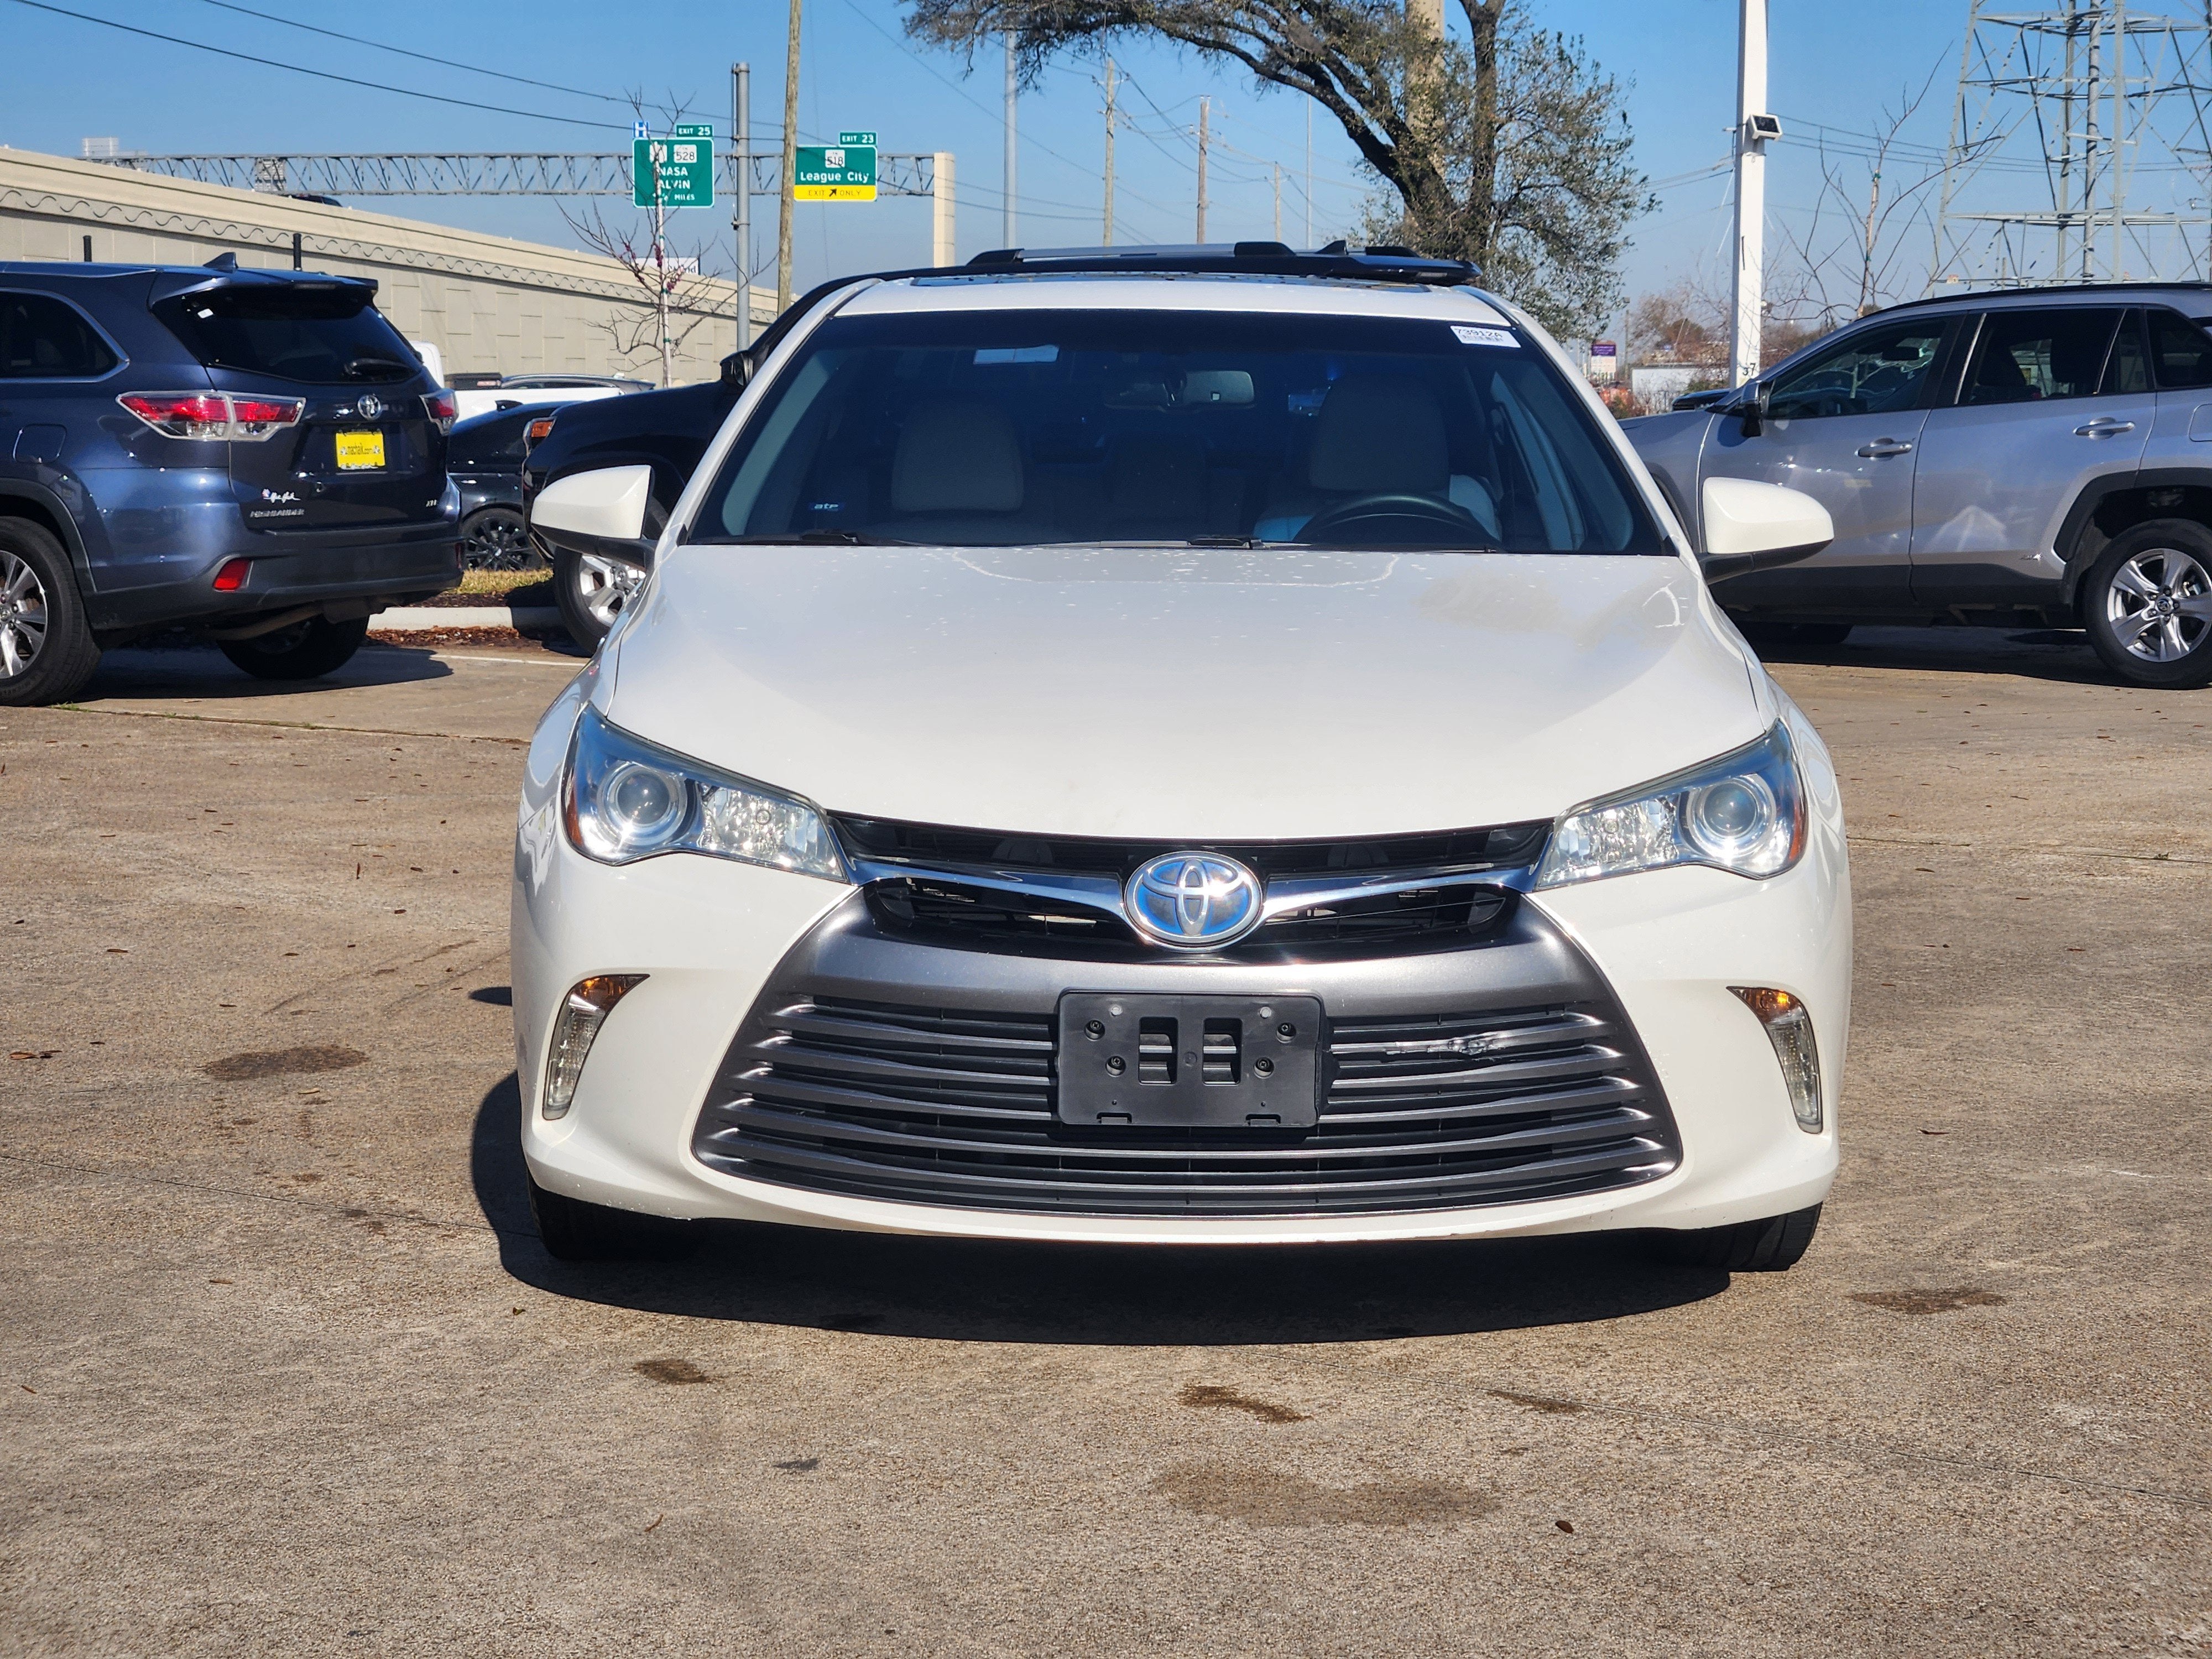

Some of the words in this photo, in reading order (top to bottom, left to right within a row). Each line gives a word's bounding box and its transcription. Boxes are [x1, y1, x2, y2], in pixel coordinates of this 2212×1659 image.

[697, 127, 711, 135] 25
[862, 134, 874, 143] 23
[676, 152, 695, 161] 528
[827, 156, 843, 166] 518
[659, 166, 688, 176] NASA
[800, 171, 841, 183] League
[847, 171, 869, 183] City
[658, 180, 690, 189] ALVIN
[1742, 362, 1756, 375] 37
